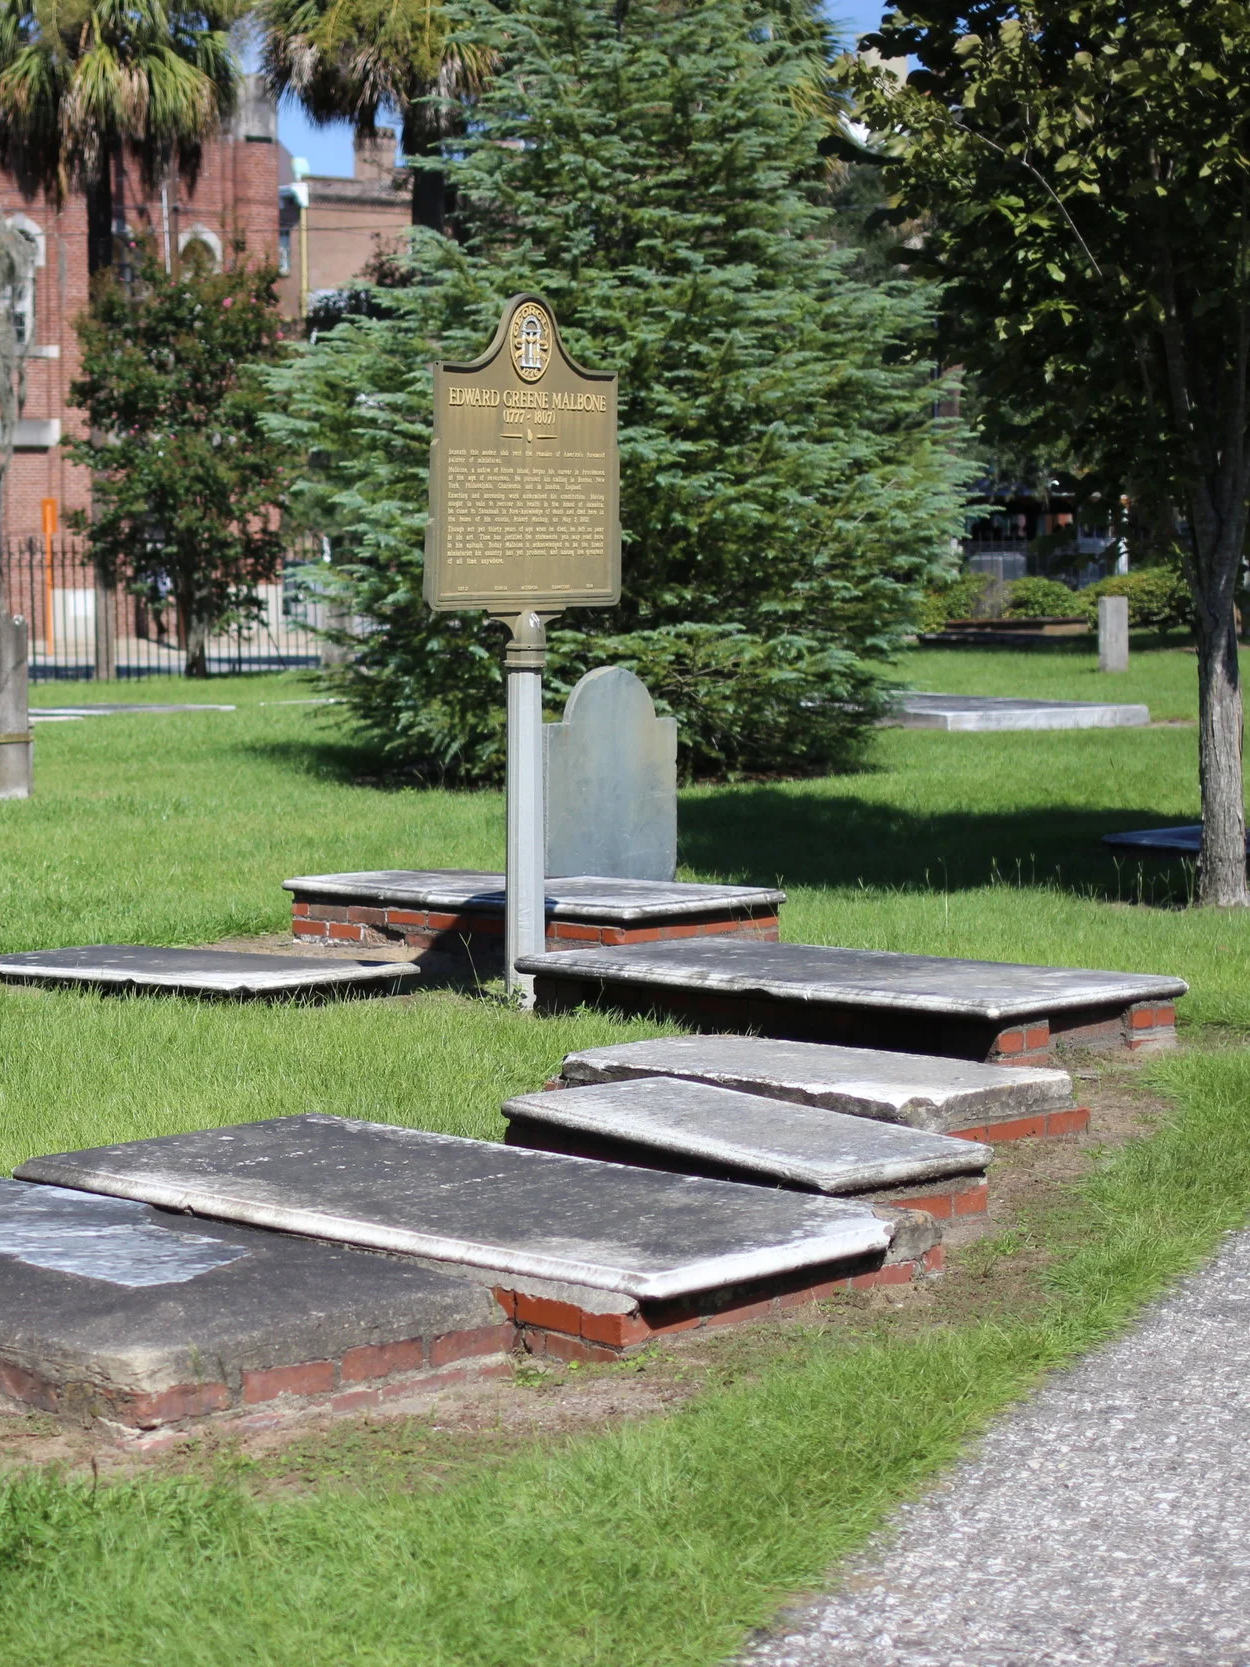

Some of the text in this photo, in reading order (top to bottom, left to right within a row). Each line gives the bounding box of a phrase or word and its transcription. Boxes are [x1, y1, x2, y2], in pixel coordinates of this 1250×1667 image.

[513, 305, 549, 337] GEORGIA
[522, 367, 539, 377] 1776
[448, 387, 607, 411] EDWARD GREENE MALBONE
[503, 410, 526, 424] (1777
[534, 411, 556, 425] 1807)
